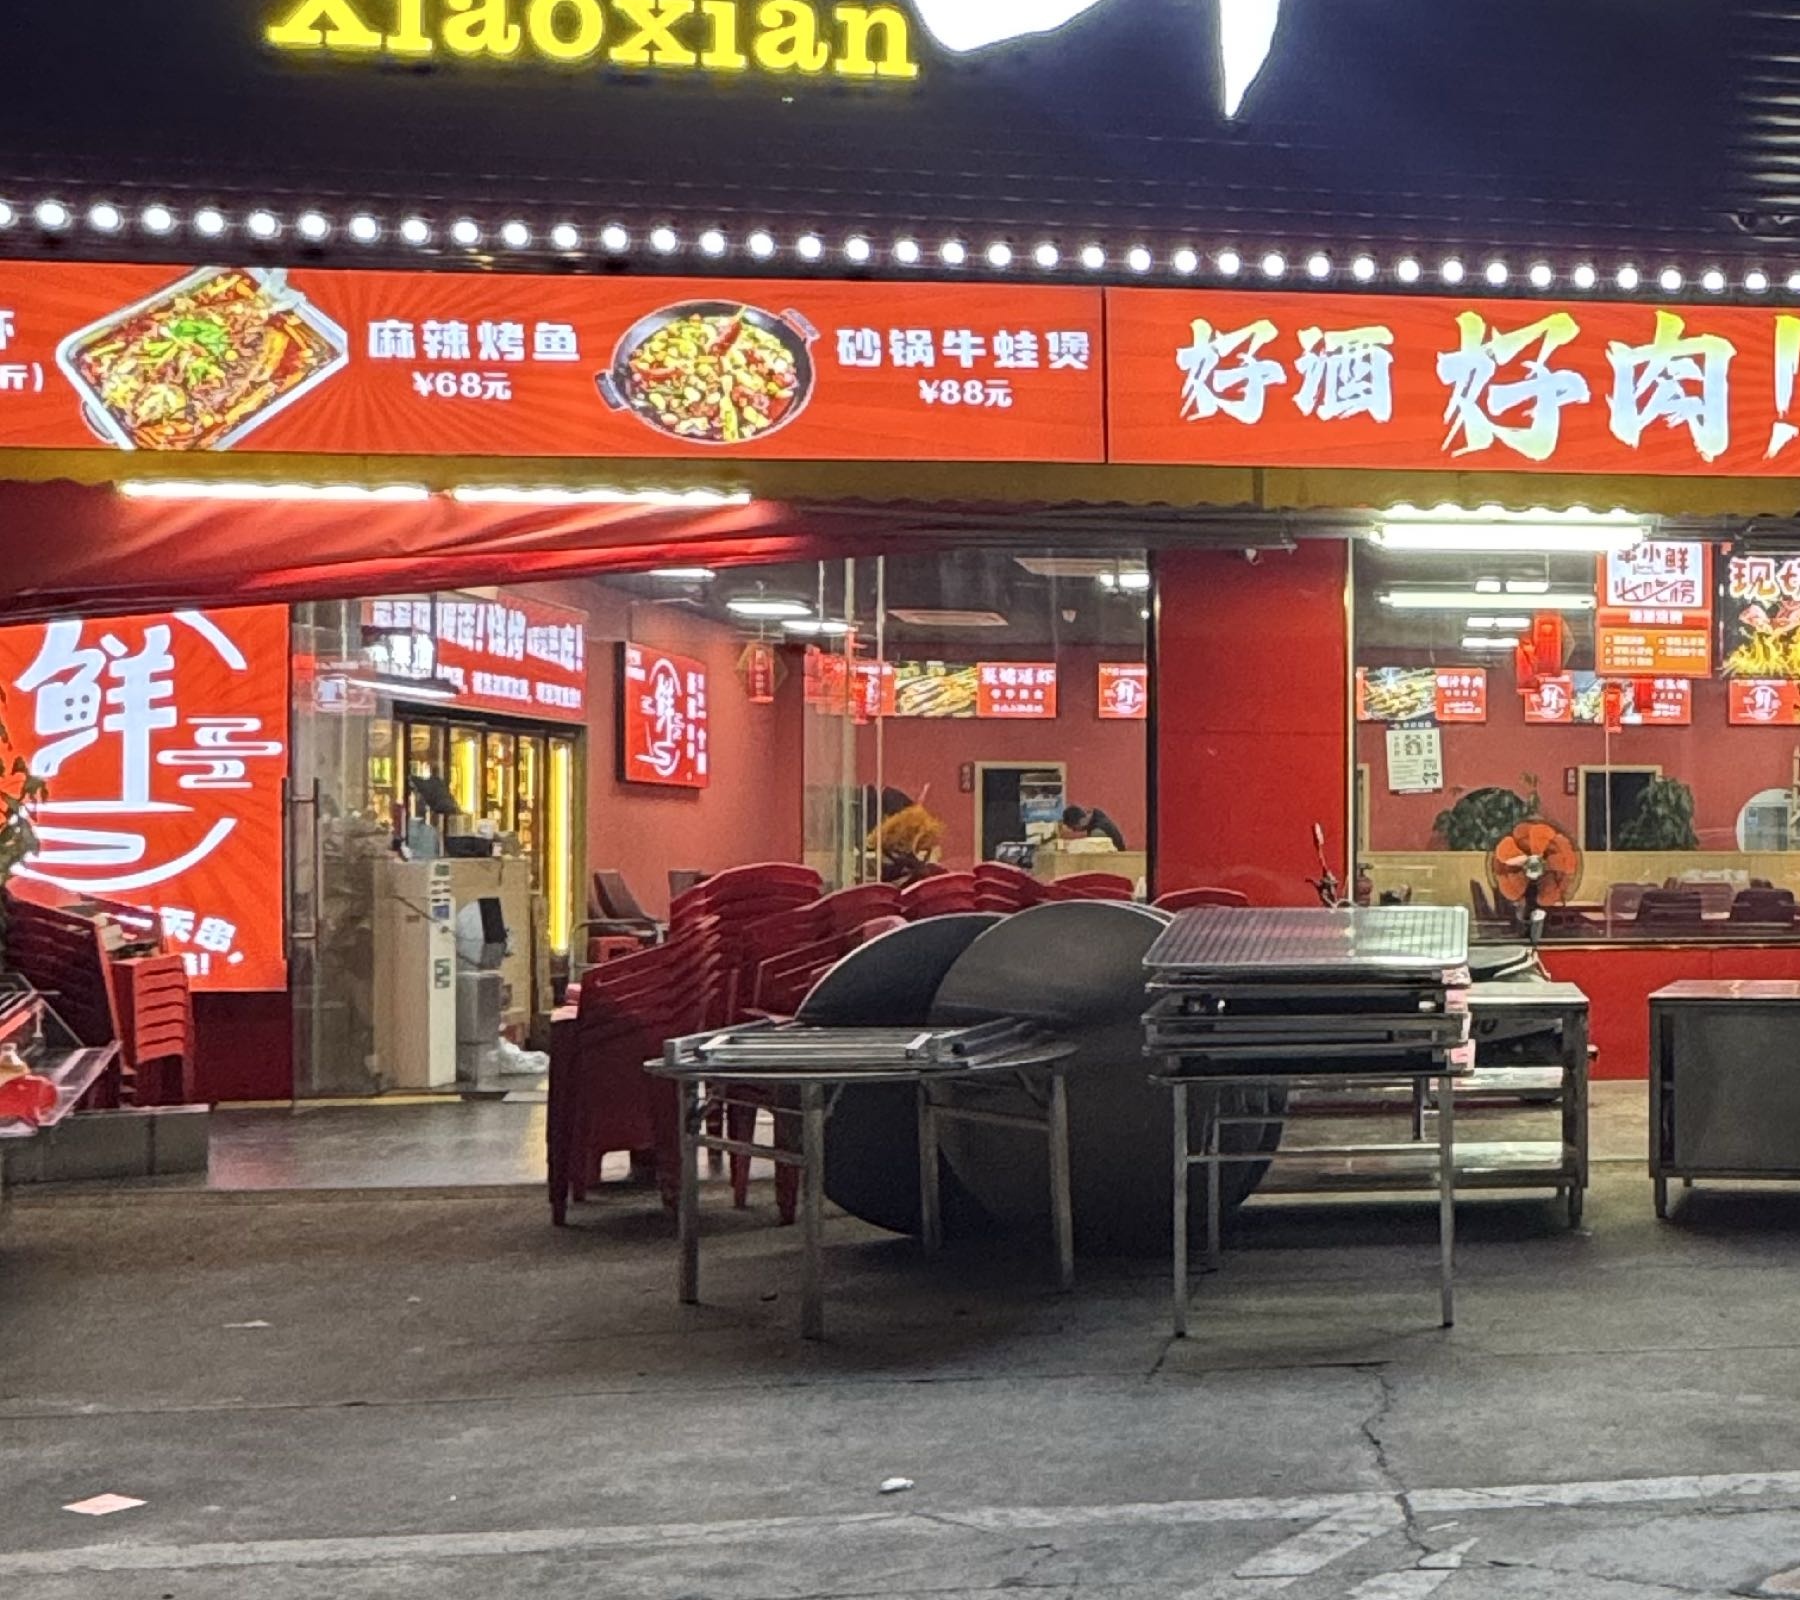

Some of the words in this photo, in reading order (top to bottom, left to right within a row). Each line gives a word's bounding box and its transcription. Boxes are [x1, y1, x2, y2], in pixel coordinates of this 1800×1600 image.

[367, 319, 580, 362] 麻辣烤鱼
[836, 329, 1091, 371] 砂锅牛蛙煲
[412, 371, 513, 400] ¥68元
[919, 379, 1013, 408] ¥88元
